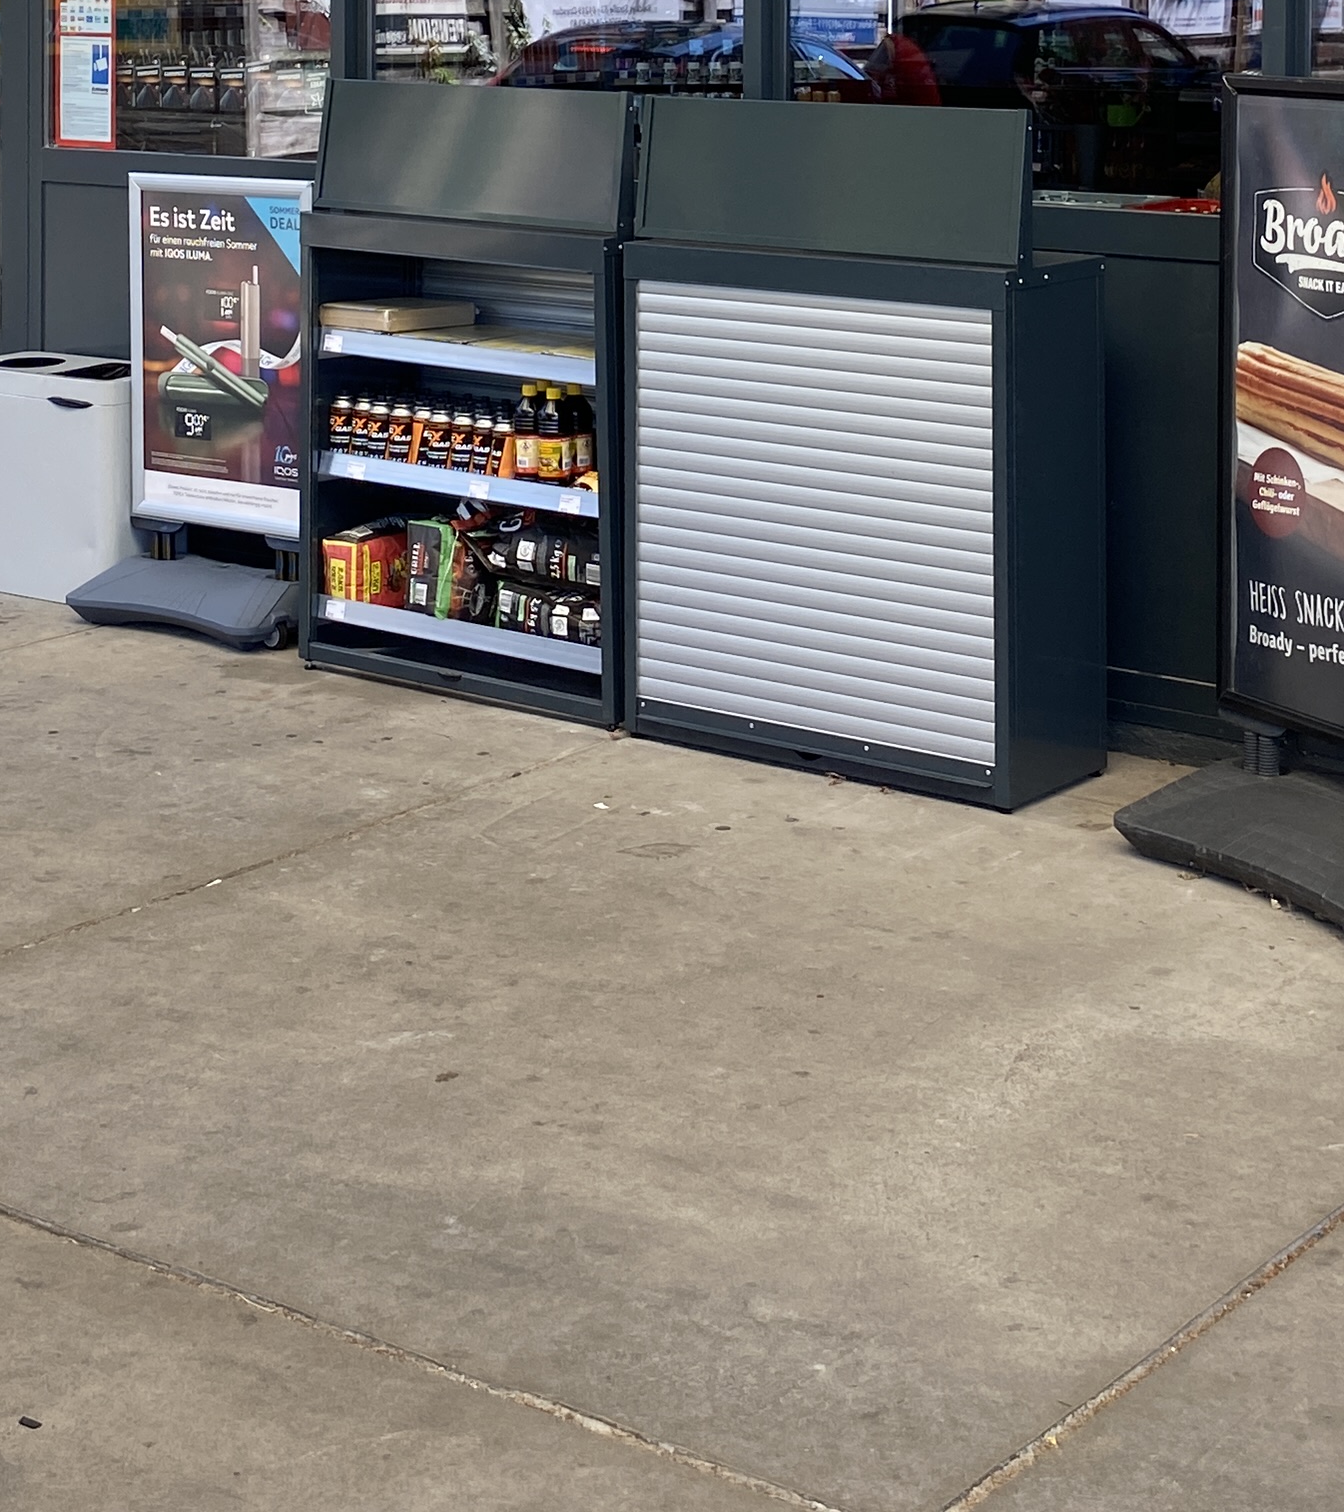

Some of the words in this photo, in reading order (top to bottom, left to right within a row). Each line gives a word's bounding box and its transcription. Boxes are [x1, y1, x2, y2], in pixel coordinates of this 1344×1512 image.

[269, 205, 300, 215] SOMMER
[149, 205, 169, 227] Es
[173, 206, 197, 230] ist
[199, 209, 236, 232] Zeit
[269, 217, 300, 231] DEAL
[149, 233, 161, 244] für
[162, 235, 182, 246] einen
[183, 236, 225, 249] rauchfreien
[226, 239, 258, 251] Sommer
[150, 248, 163, 258] mit
[164, 248, 185, 259] IQOS
[1298, 275, 1325, 292] SNACK
[1325, 279, 1334, 293] IT
[274, 465, 300, 478] IQOS
[1278, 490, 1295, 501] oder
[1249, 579, 1287, 620] HEISS
[1249, 624, 1293, 657] Broady
